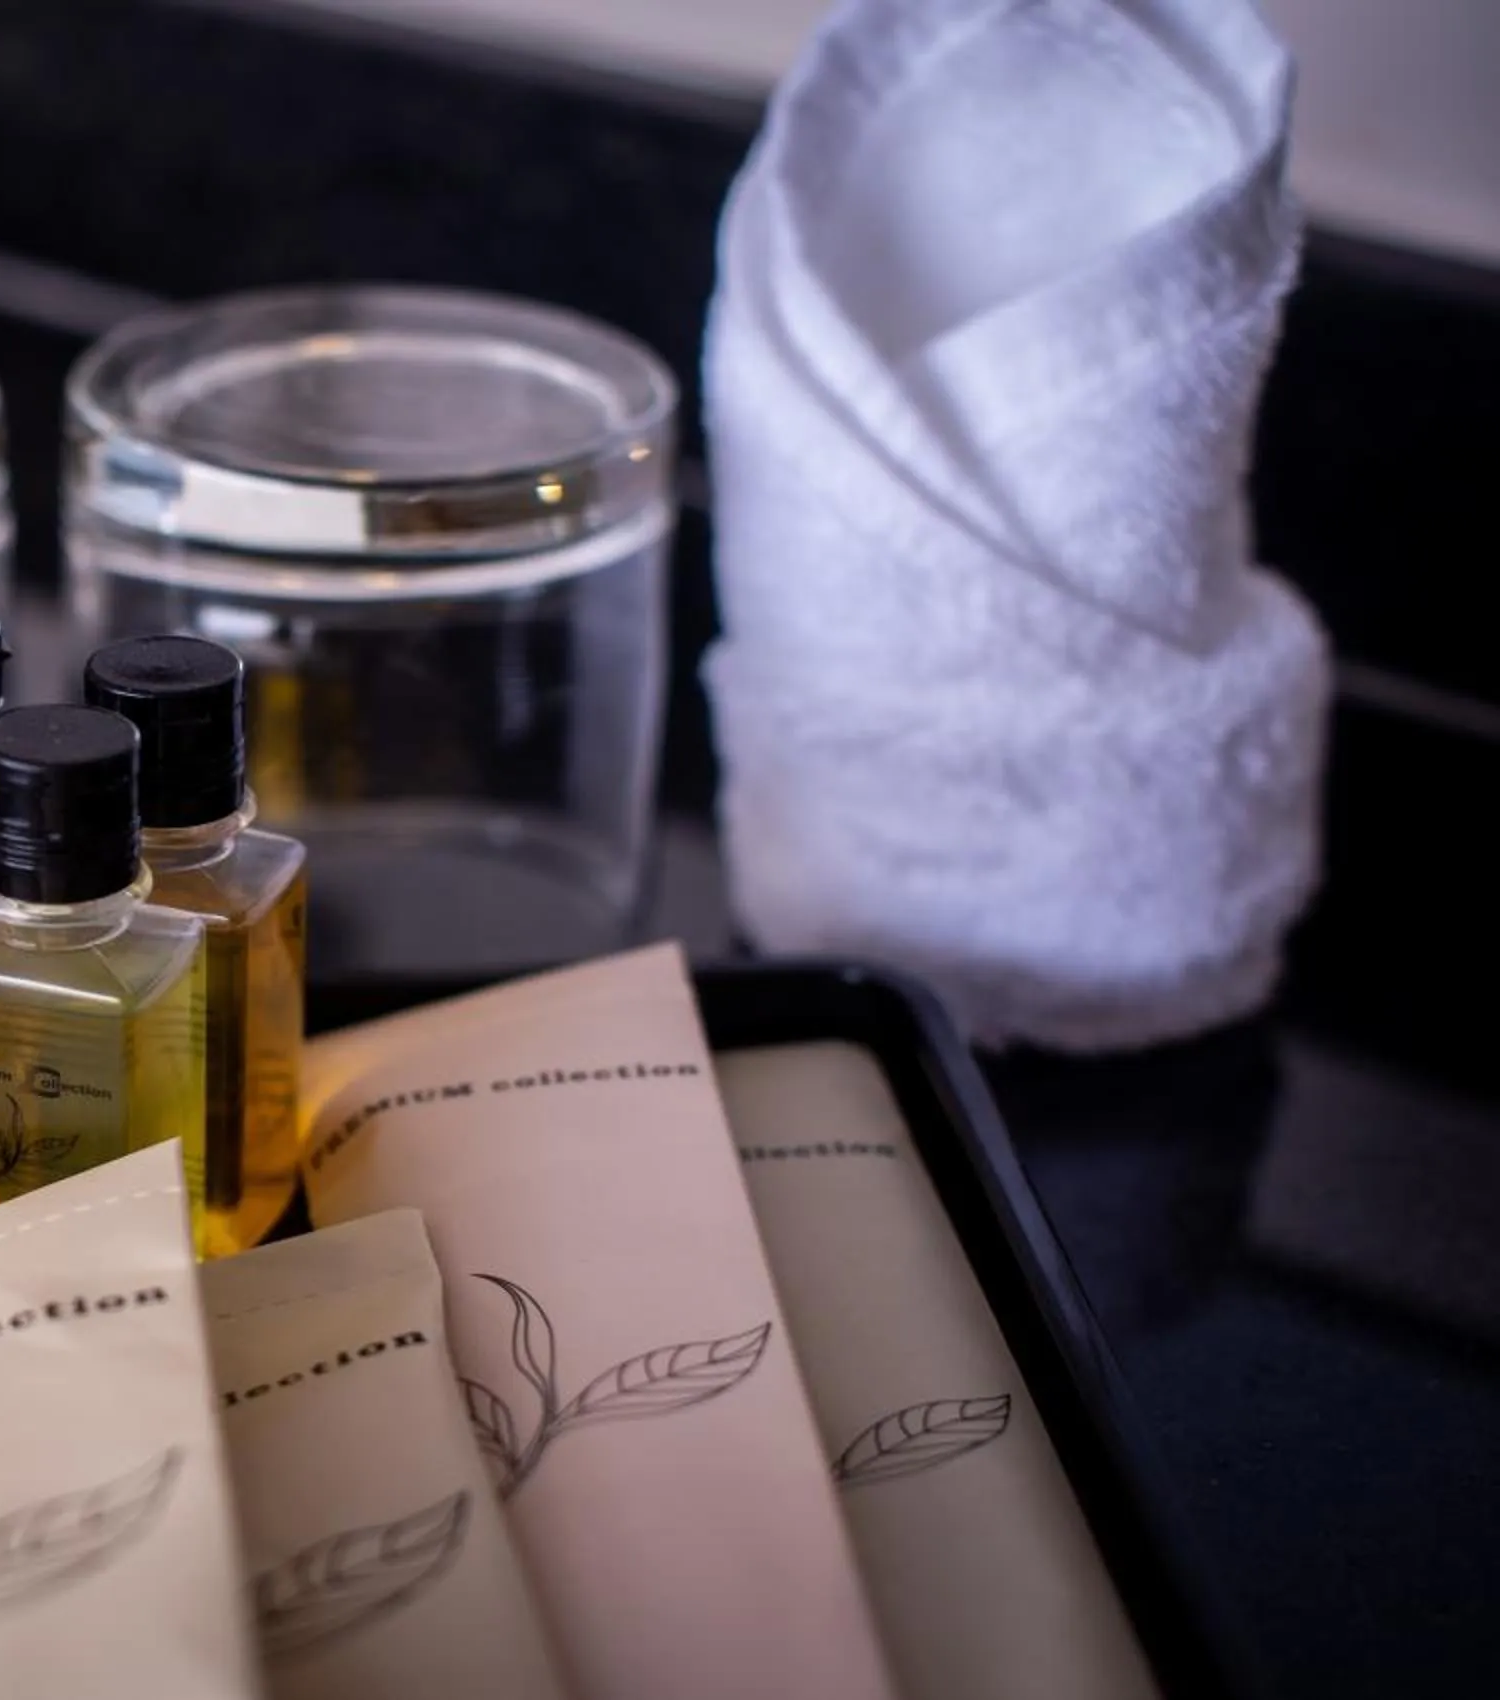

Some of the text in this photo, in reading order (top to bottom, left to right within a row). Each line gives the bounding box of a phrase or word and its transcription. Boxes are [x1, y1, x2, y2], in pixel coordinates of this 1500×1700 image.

[311, 1063, 699, 1171] PREMIUM collection
[739, 1141, 898, 1163] llection
[223, 1331, 428, 1407] lection
